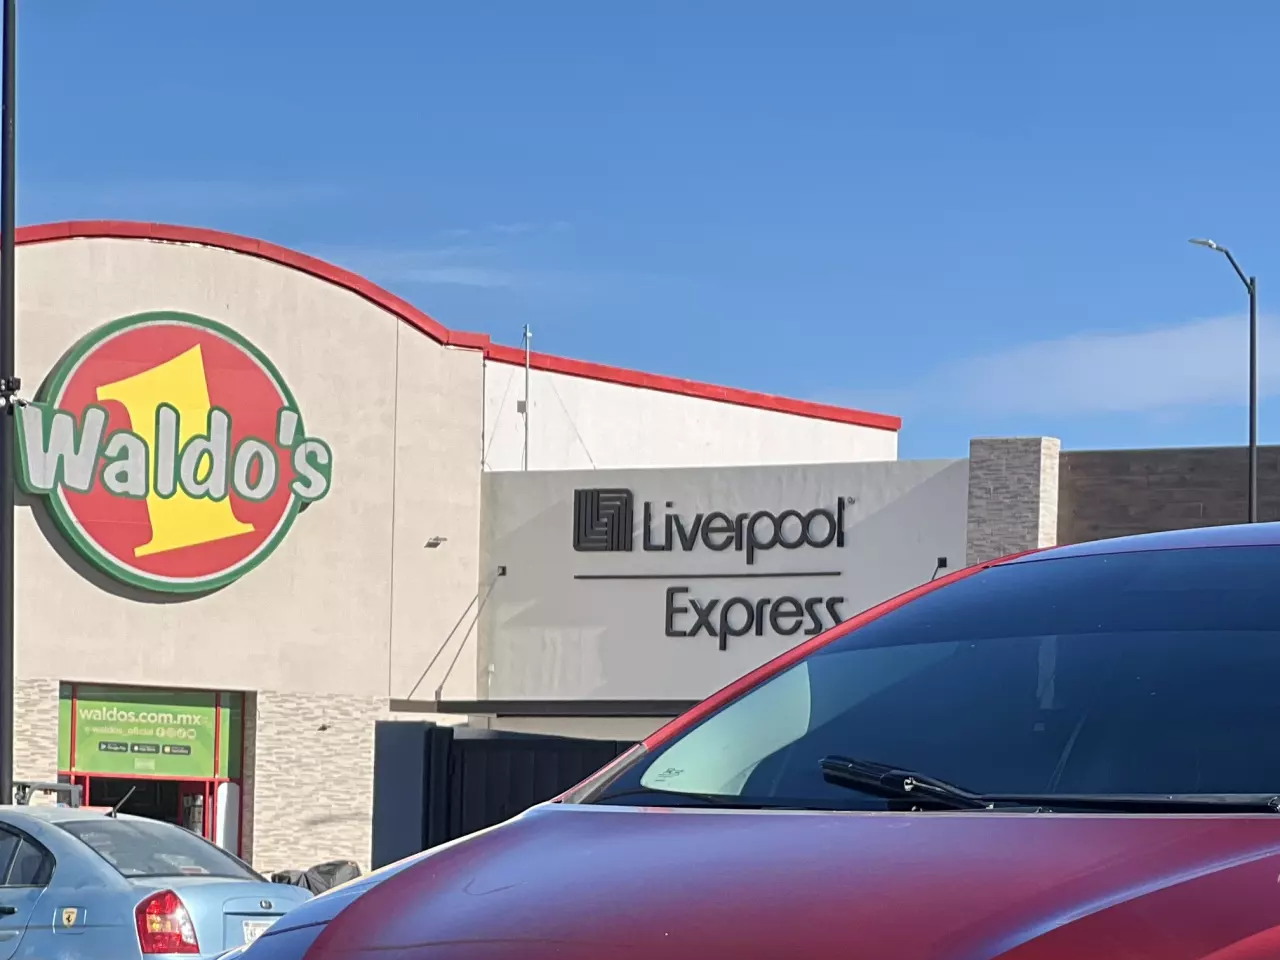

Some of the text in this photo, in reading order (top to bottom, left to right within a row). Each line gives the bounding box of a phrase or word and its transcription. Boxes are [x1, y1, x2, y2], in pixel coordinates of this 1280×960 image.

[16, 402, 332, 502] Waldo's
[642, 496, 845, 565] Liverpool
[664, 586, 845, 652] Express
[79, 706, 202, 726] waldos.com.mx
